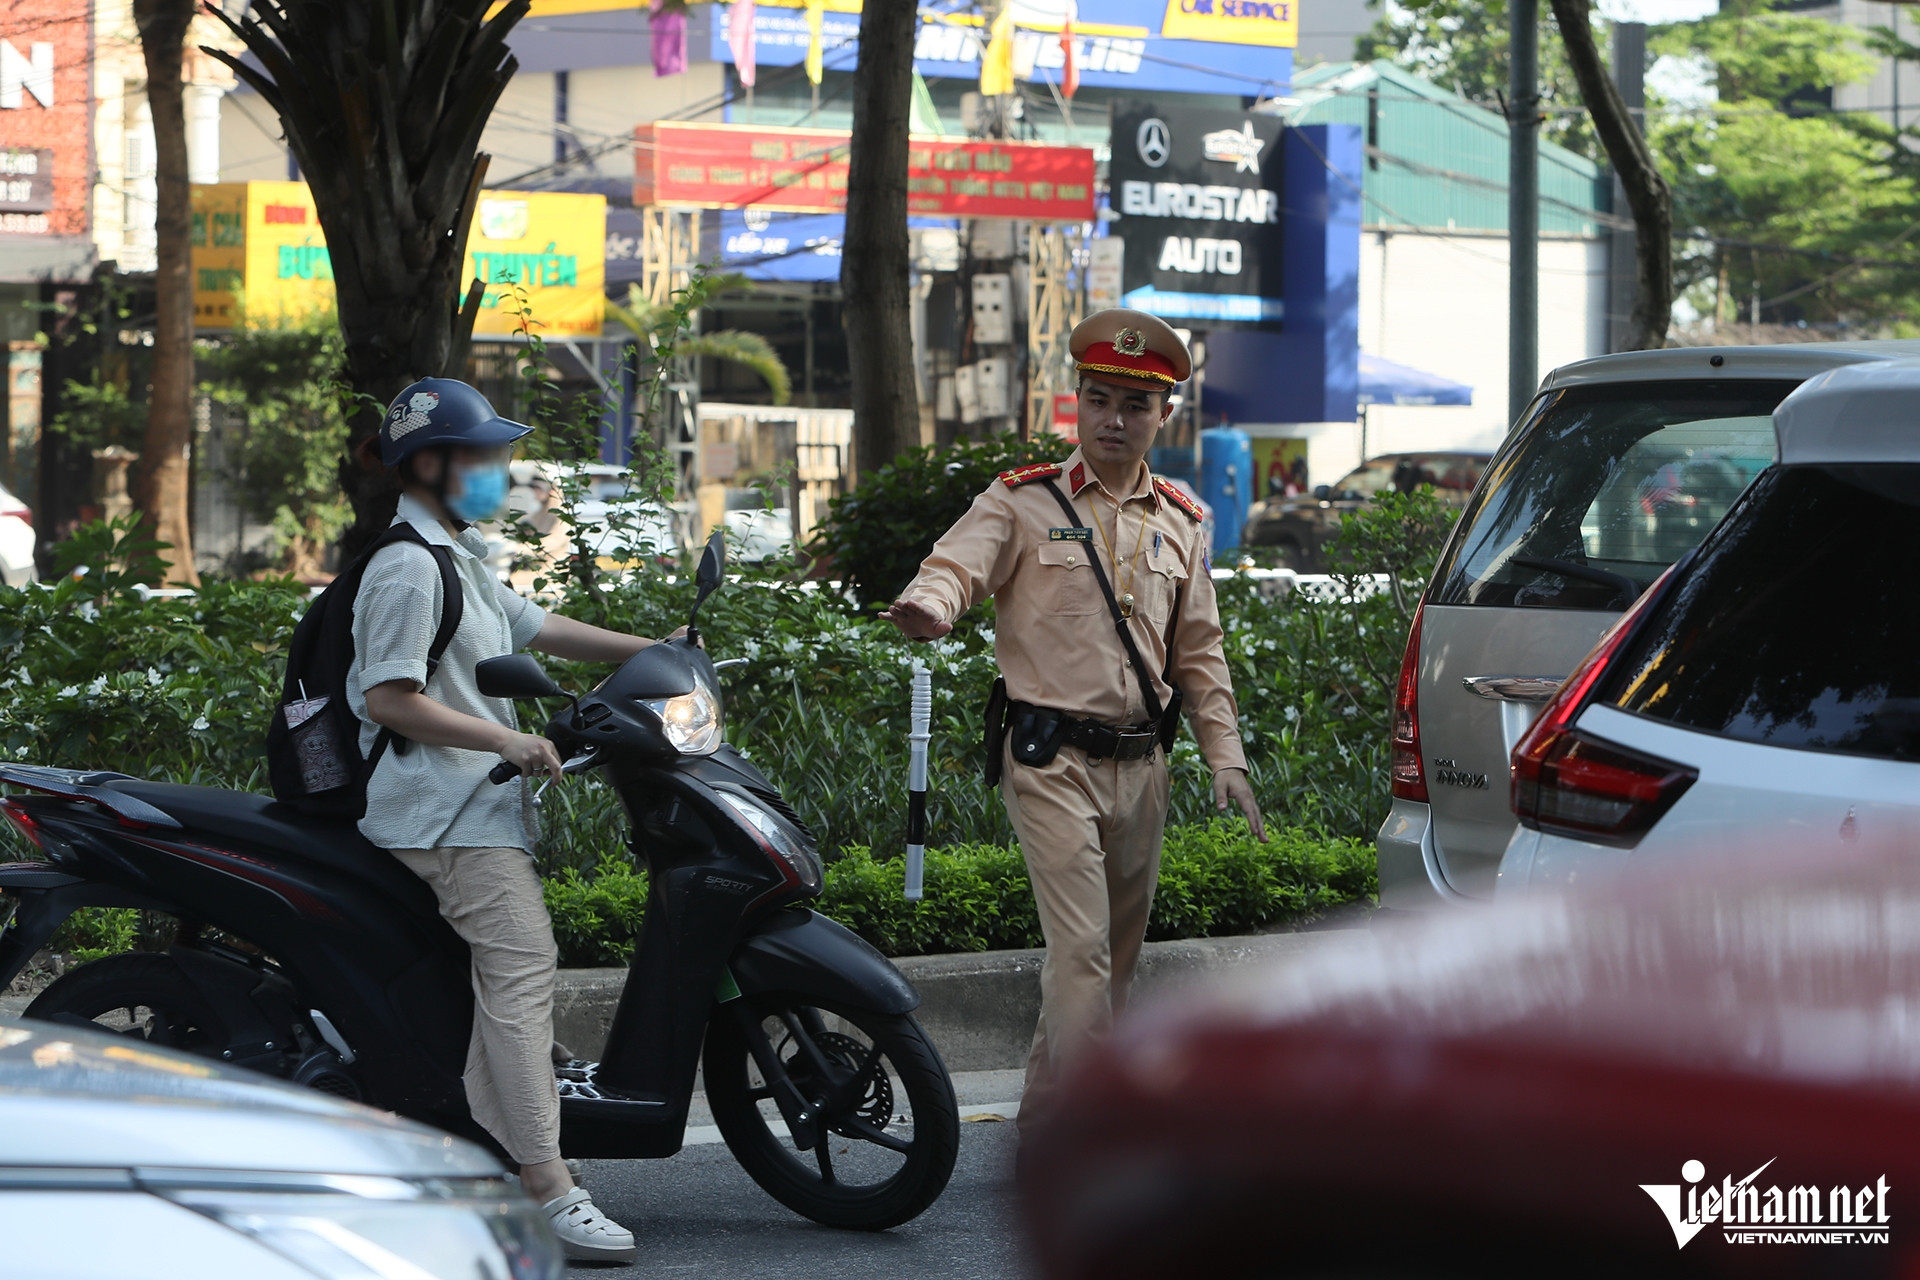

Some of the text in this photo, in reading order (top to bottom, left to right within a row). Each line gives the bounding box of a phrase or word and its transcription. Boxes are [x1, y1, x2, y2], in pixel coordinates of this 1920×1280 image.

[1221, 0, 1289, 21] SERVICE
[1122, 180, 1278, 224] EUROSTAR
[1158, 235, 1242, 275] AUTO
[1436, 769, 1489, 790] INNOVA
[704, 875, 753, 891] SPORTY
